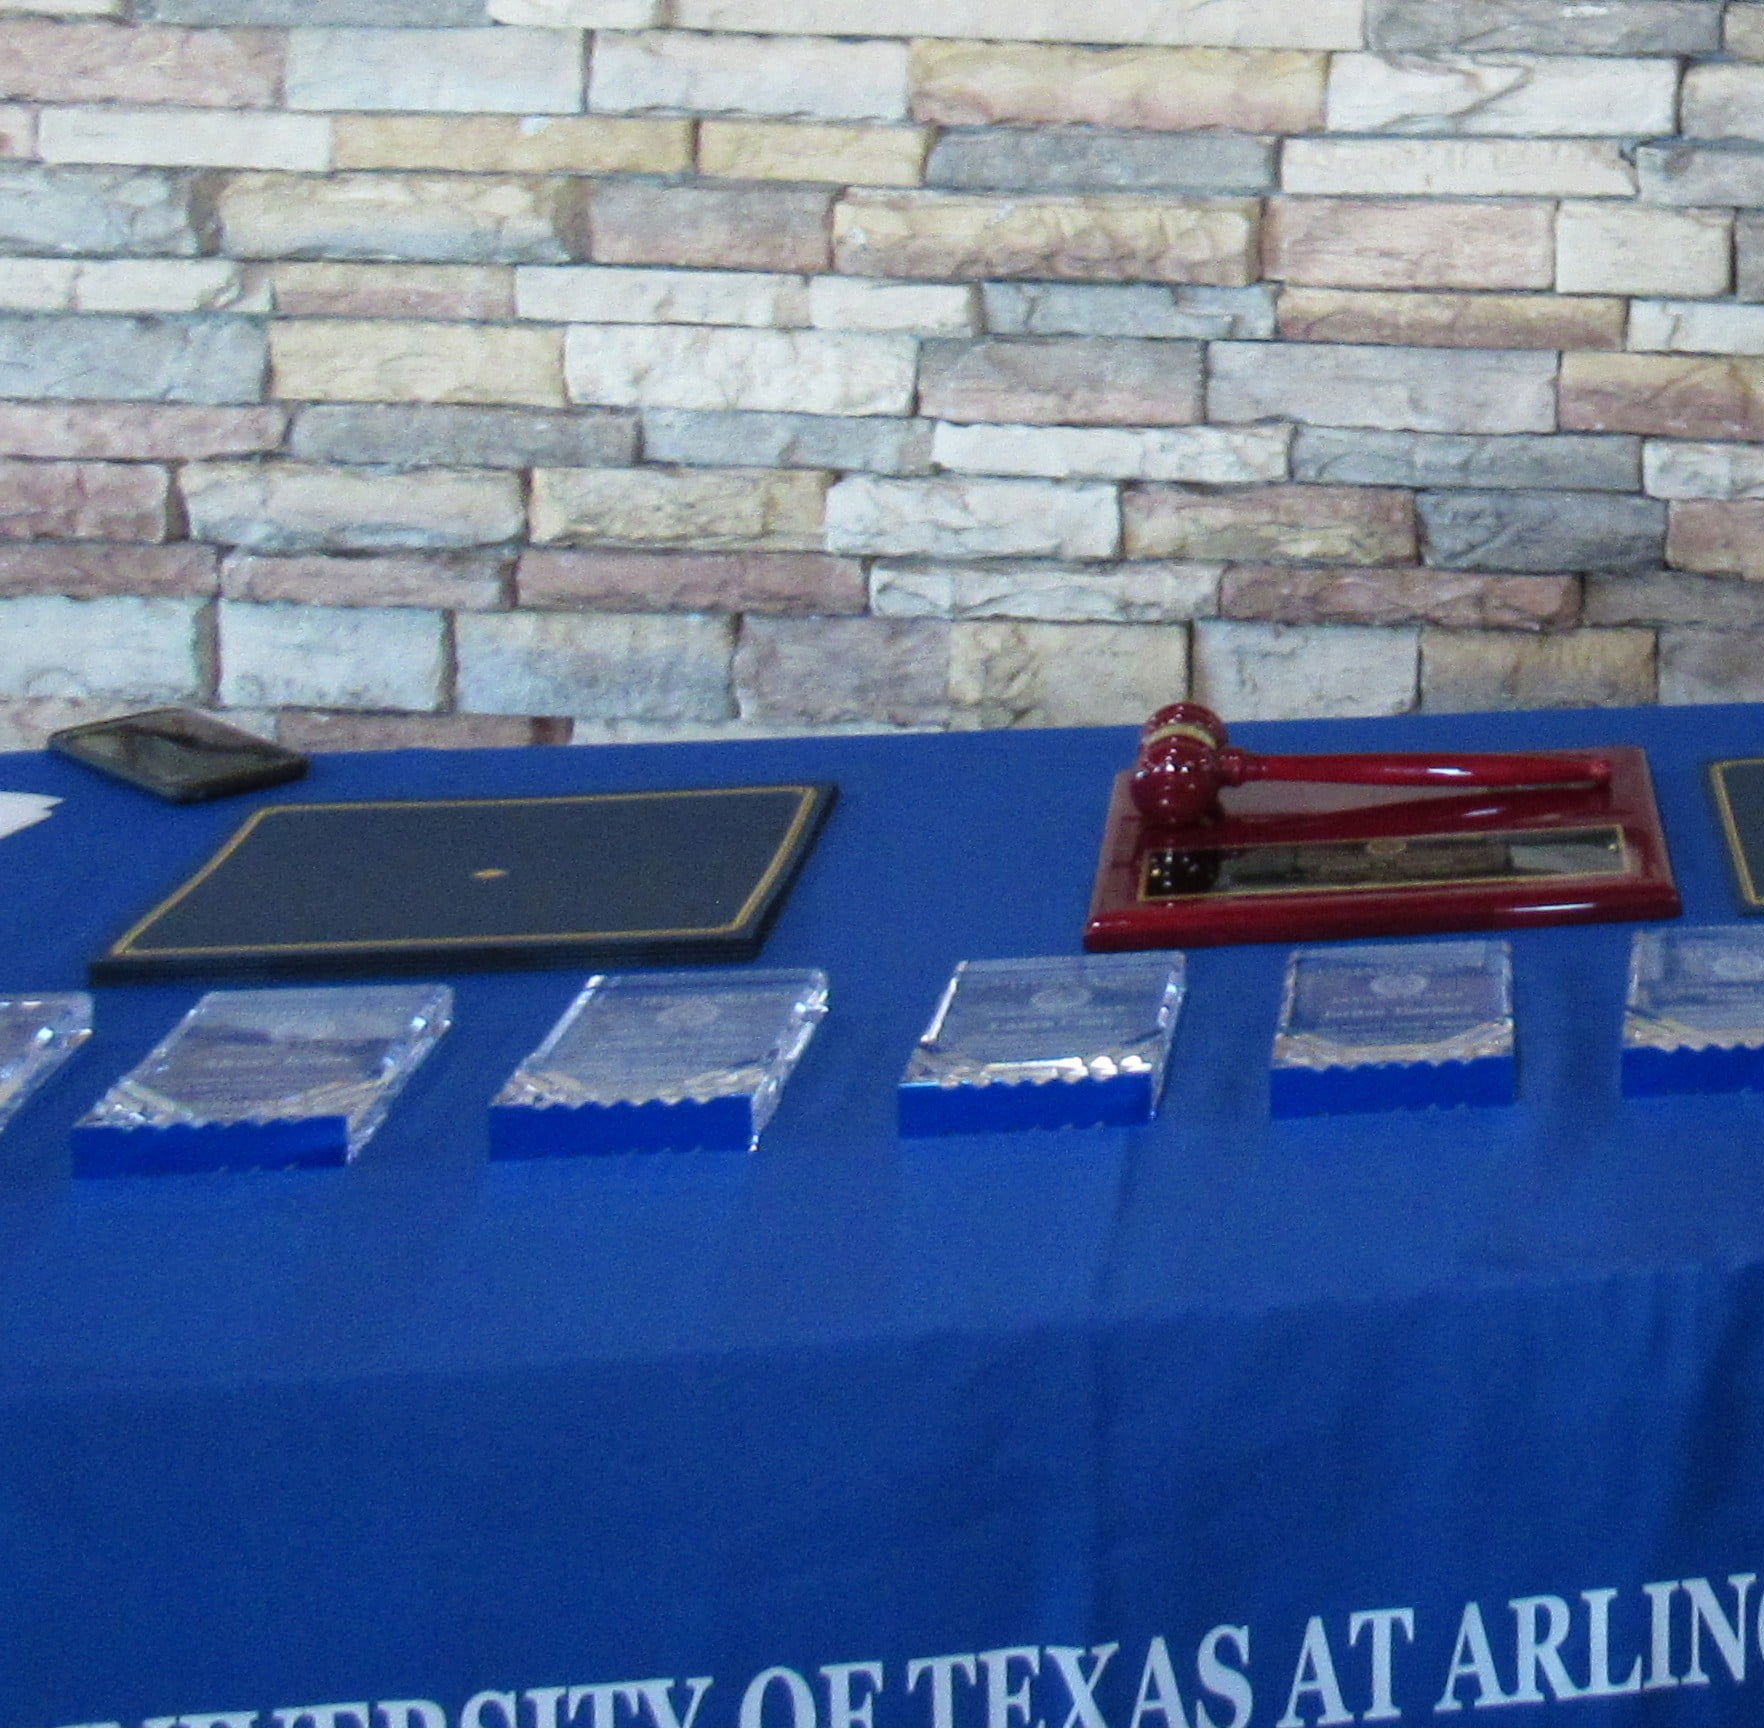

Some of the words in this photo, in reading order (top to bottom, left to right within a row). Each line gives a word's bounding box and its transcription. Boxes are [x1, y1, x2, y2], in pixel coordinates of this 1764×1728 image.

[739, 1662, 884, 1728] OF
[908, 1624, 1253, 1728] TEXAS
[1276, 1607, 1414, 1728] AT
